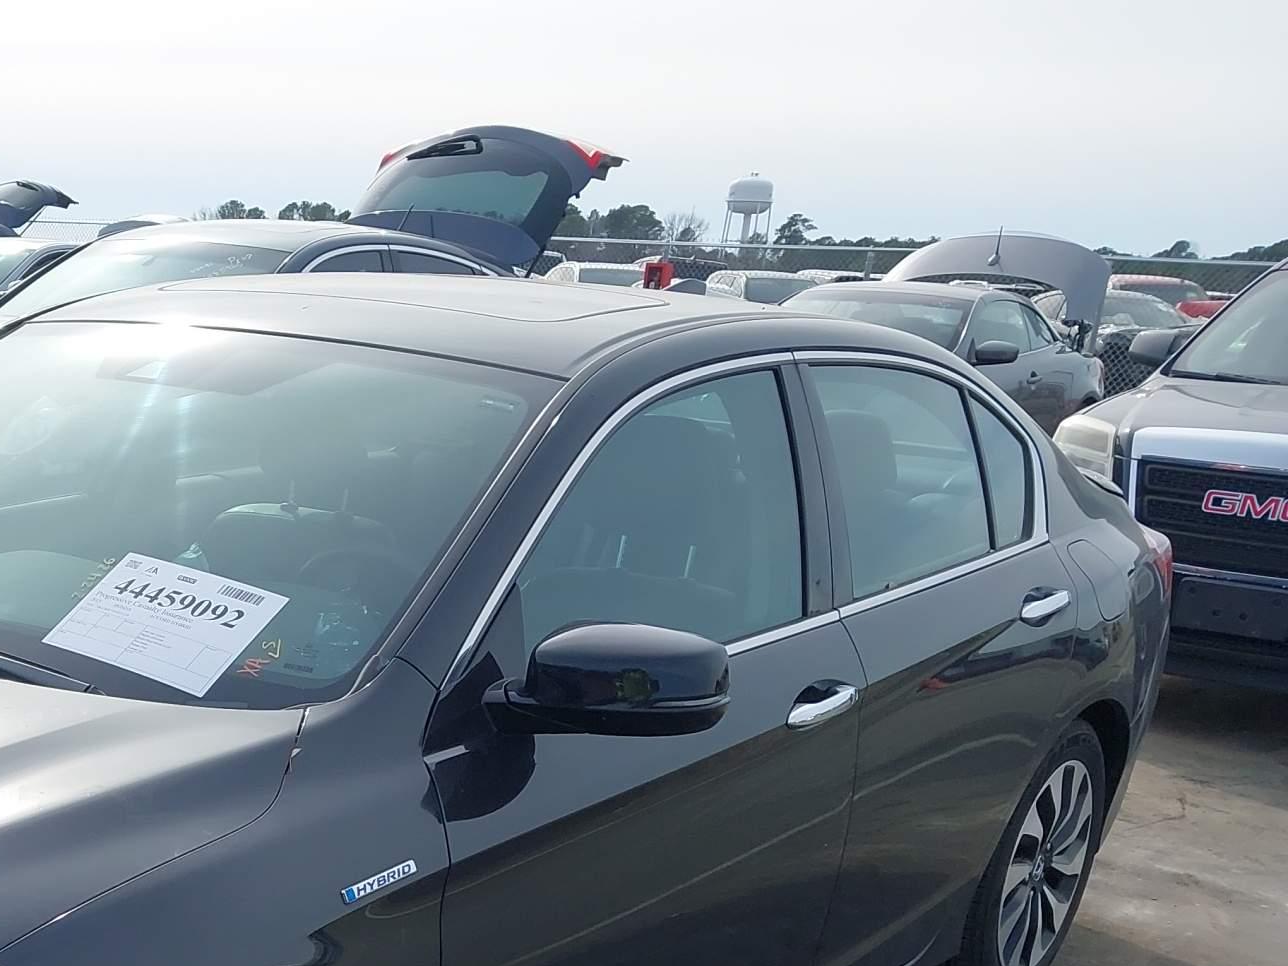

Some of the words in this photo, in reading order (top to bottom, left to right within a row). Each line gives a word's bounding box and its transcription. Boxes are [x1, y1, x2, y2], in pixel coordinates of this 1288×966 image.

[1201, 489, 1288, 522] GM
[114, 578, 245, 629] 44459092
[356, 863, 412, 896] HYBRID
